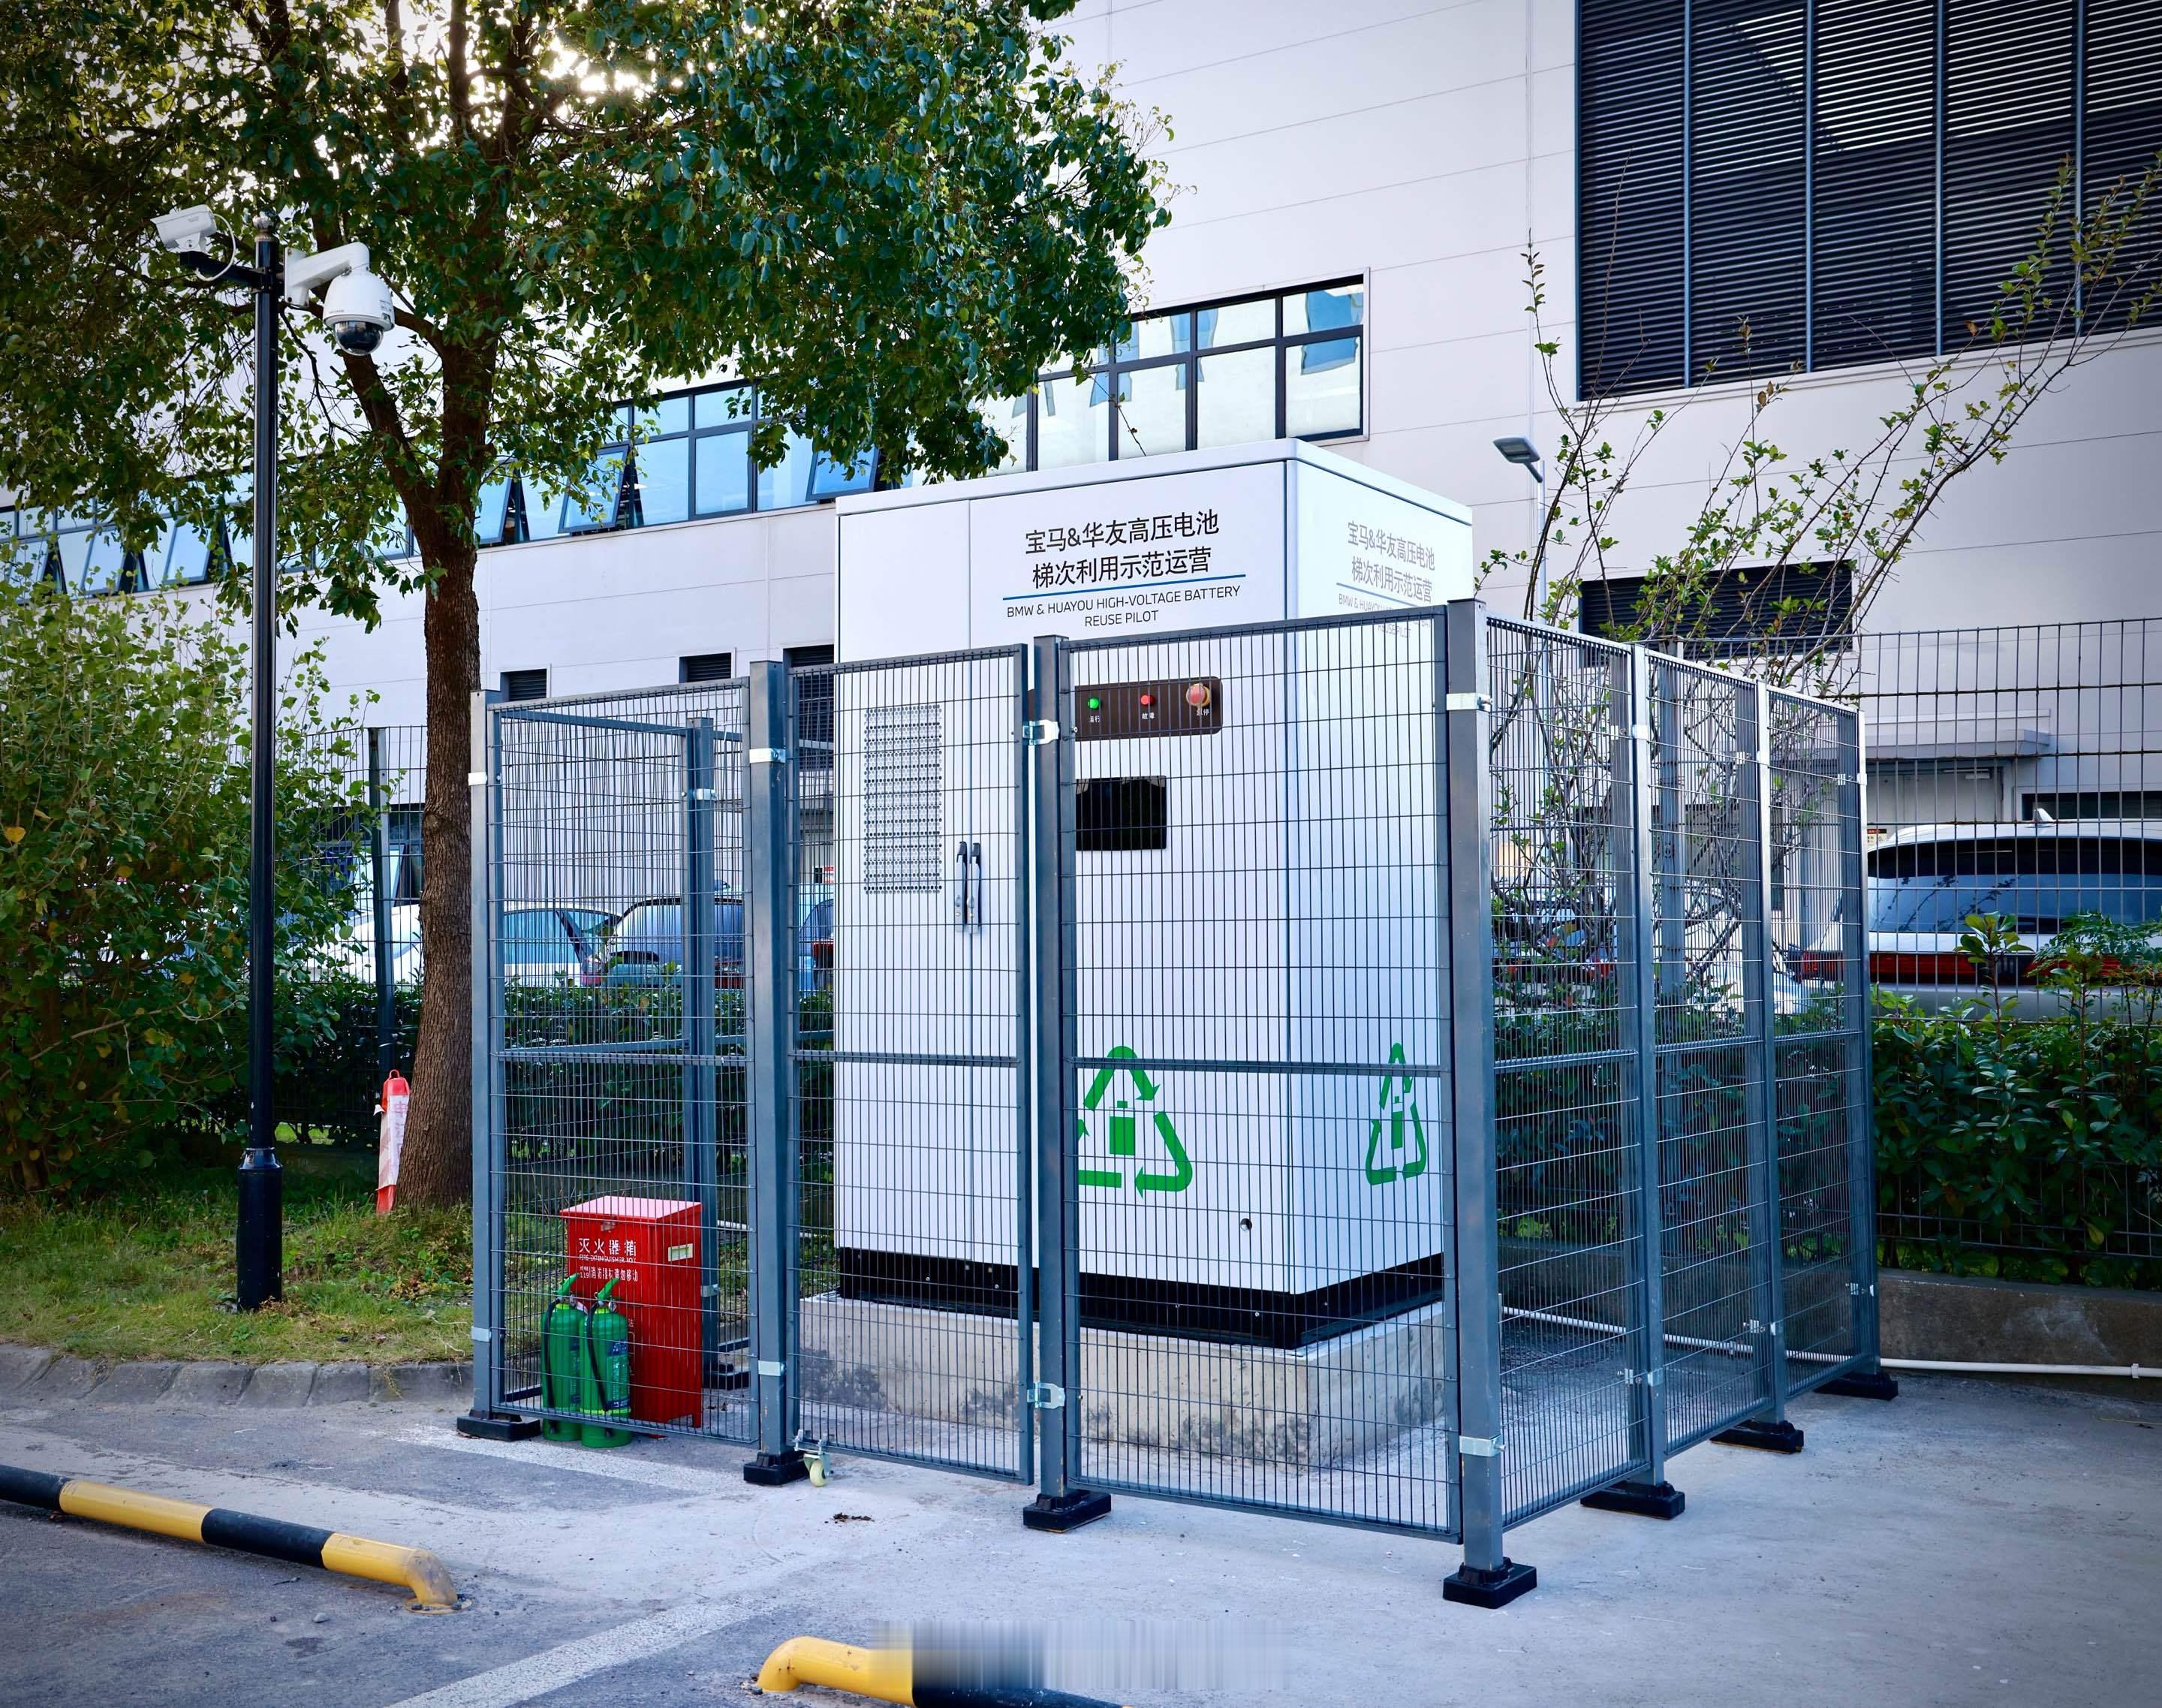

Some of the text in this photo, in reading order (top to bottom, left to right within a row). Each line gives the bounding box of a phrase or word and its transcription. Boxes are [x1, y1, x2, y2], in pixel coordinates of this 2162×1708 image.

[1025, 509, 1219, 554] 宝马&华友高压电池
[1347, 520, 1435, 571] 宝马&华友高压电池
[1032, 546, 1212, 589] 梯次利用示范运营
[1351, 556, 1432, 604] 梯次利用示范运营
[1007, 586, 1241, 618] BMW & HUAYOU HIGH-VOLTAGE BATTERY
[1085, 610, 1159, 627] REUSE PILOT
